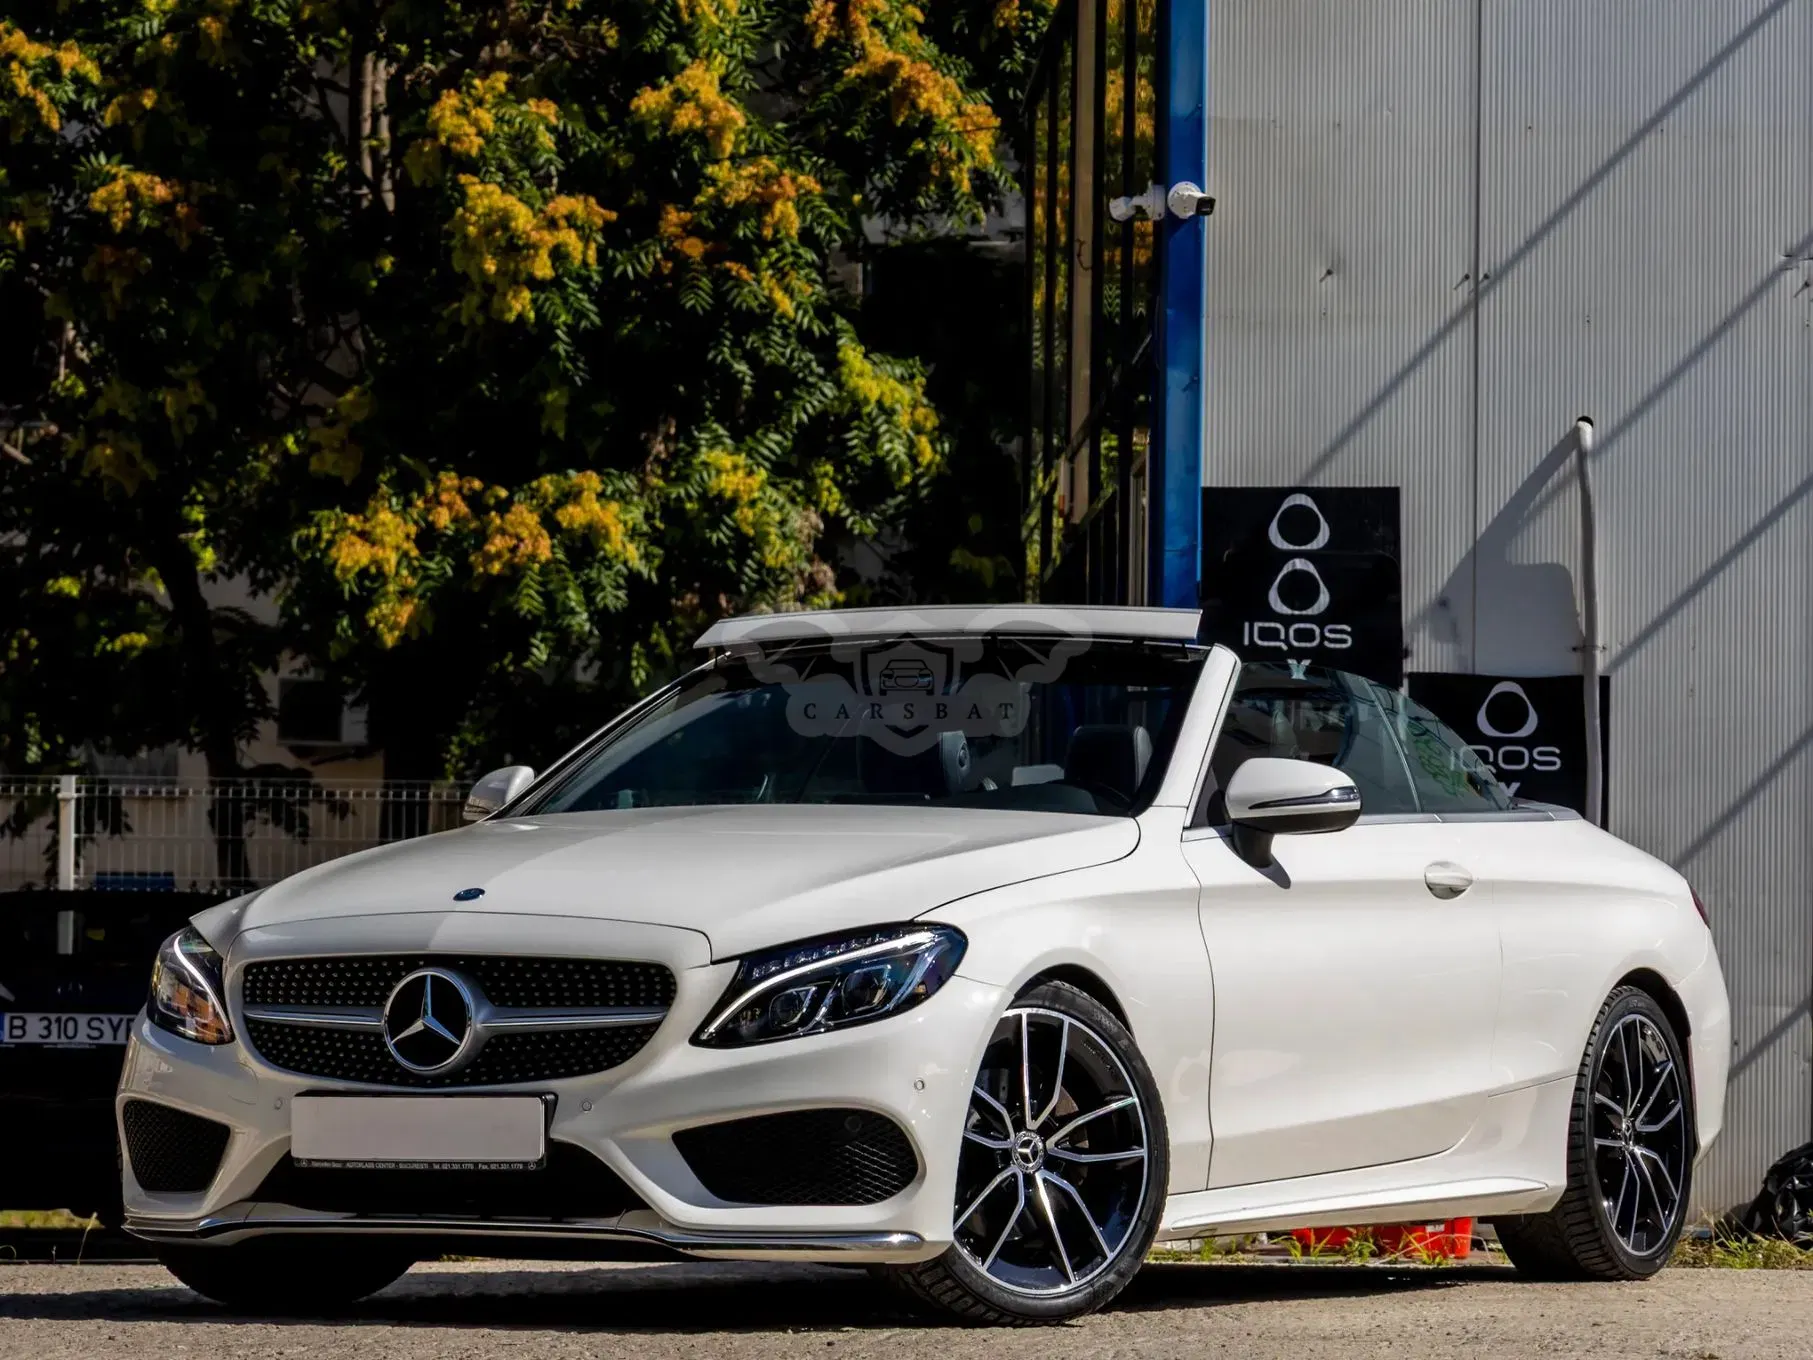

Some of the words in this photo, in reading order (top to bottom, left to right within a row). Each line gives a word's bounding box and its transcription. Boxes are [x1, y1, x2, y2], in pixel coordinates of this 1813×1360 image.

[1243, 621, 1353, 651] IQOS
[1450, 744, 1562, 774] IQOS
[8, 1015, 27, 1040] B
[38, 1016, 79, 1040] 310
